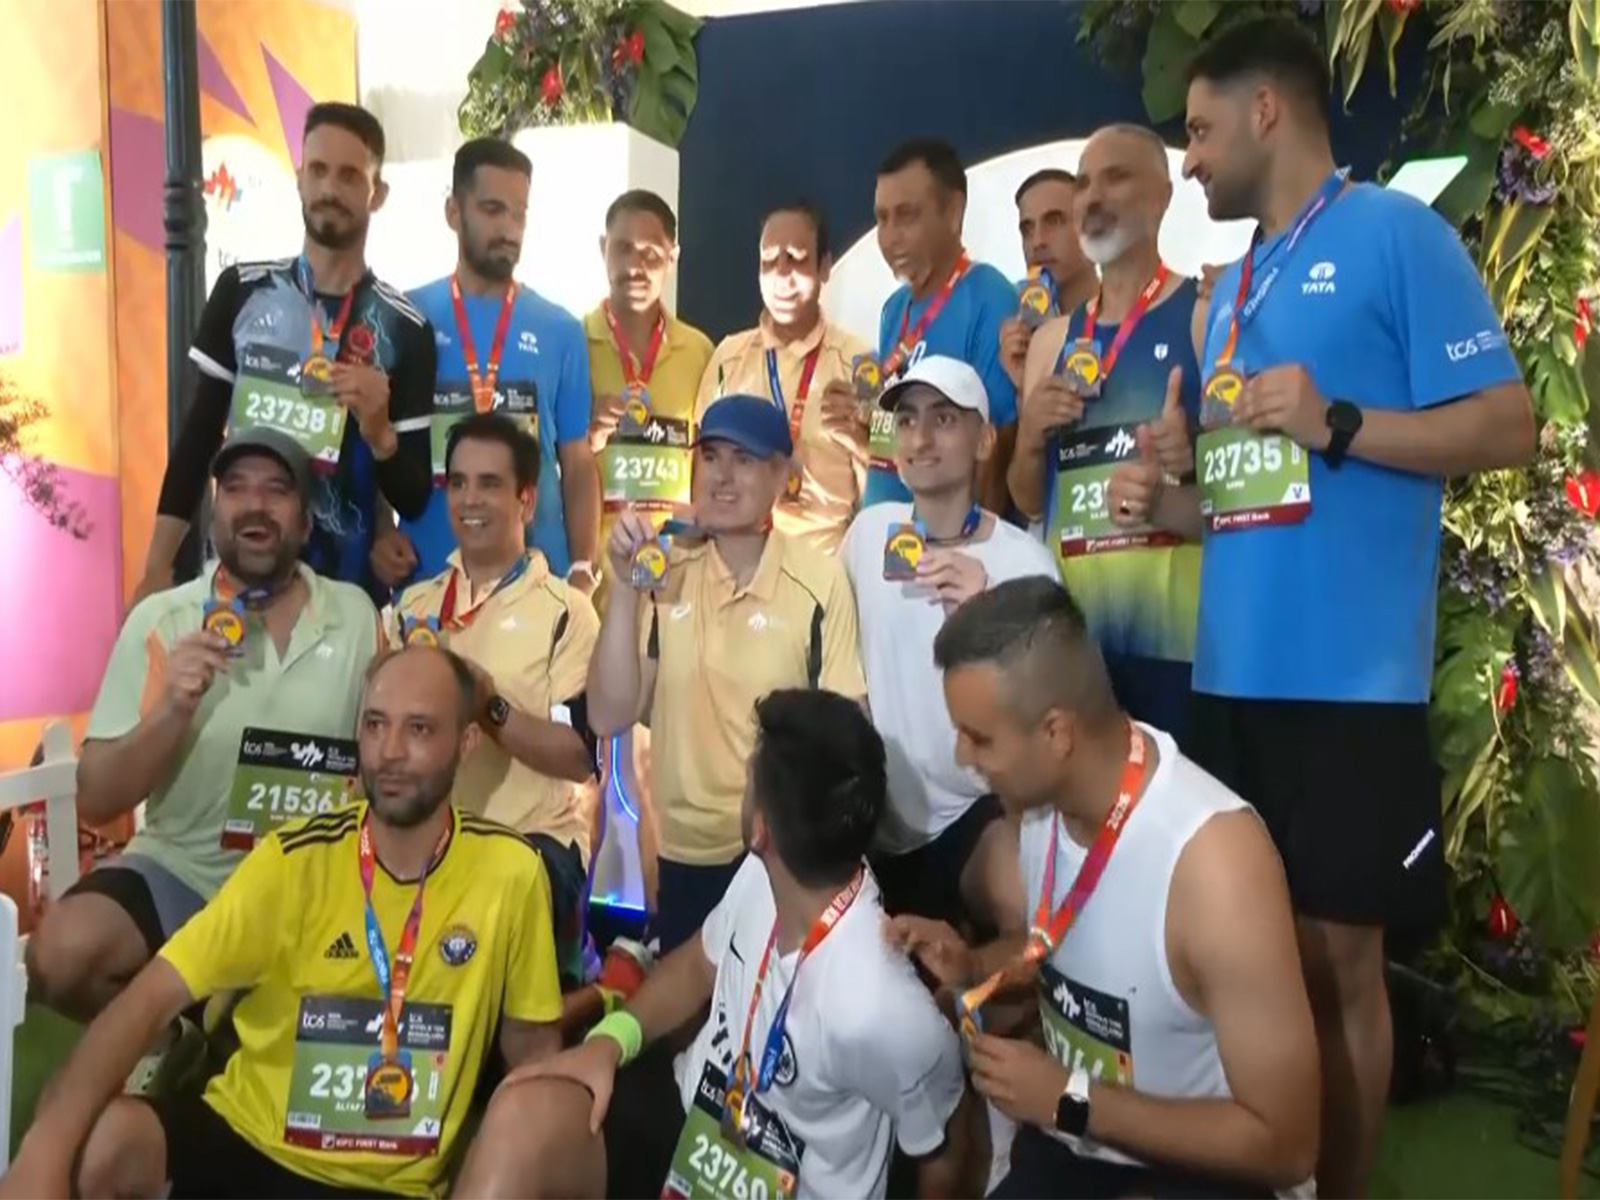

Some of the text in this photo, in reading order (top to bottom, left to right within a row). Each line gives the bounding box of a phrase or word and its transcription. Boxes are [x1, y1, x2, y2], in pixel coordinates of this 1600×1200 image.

[1301, 281, 1337, 294] TATA
[1445, 337, 1479, 362] tcs
[245, 391, 327, 434] 23738
[614, 455, 680, 482] 23743
[1204, 436, 1284, 486] 23735
[1292, 486, 1303, 500] V
[247, 782, 334, 816] 21536
[302, 1012, 326, 1030] tcs
[424, 1121, 436, 1133] V
[688, 1133, 769, 1200] 23760
